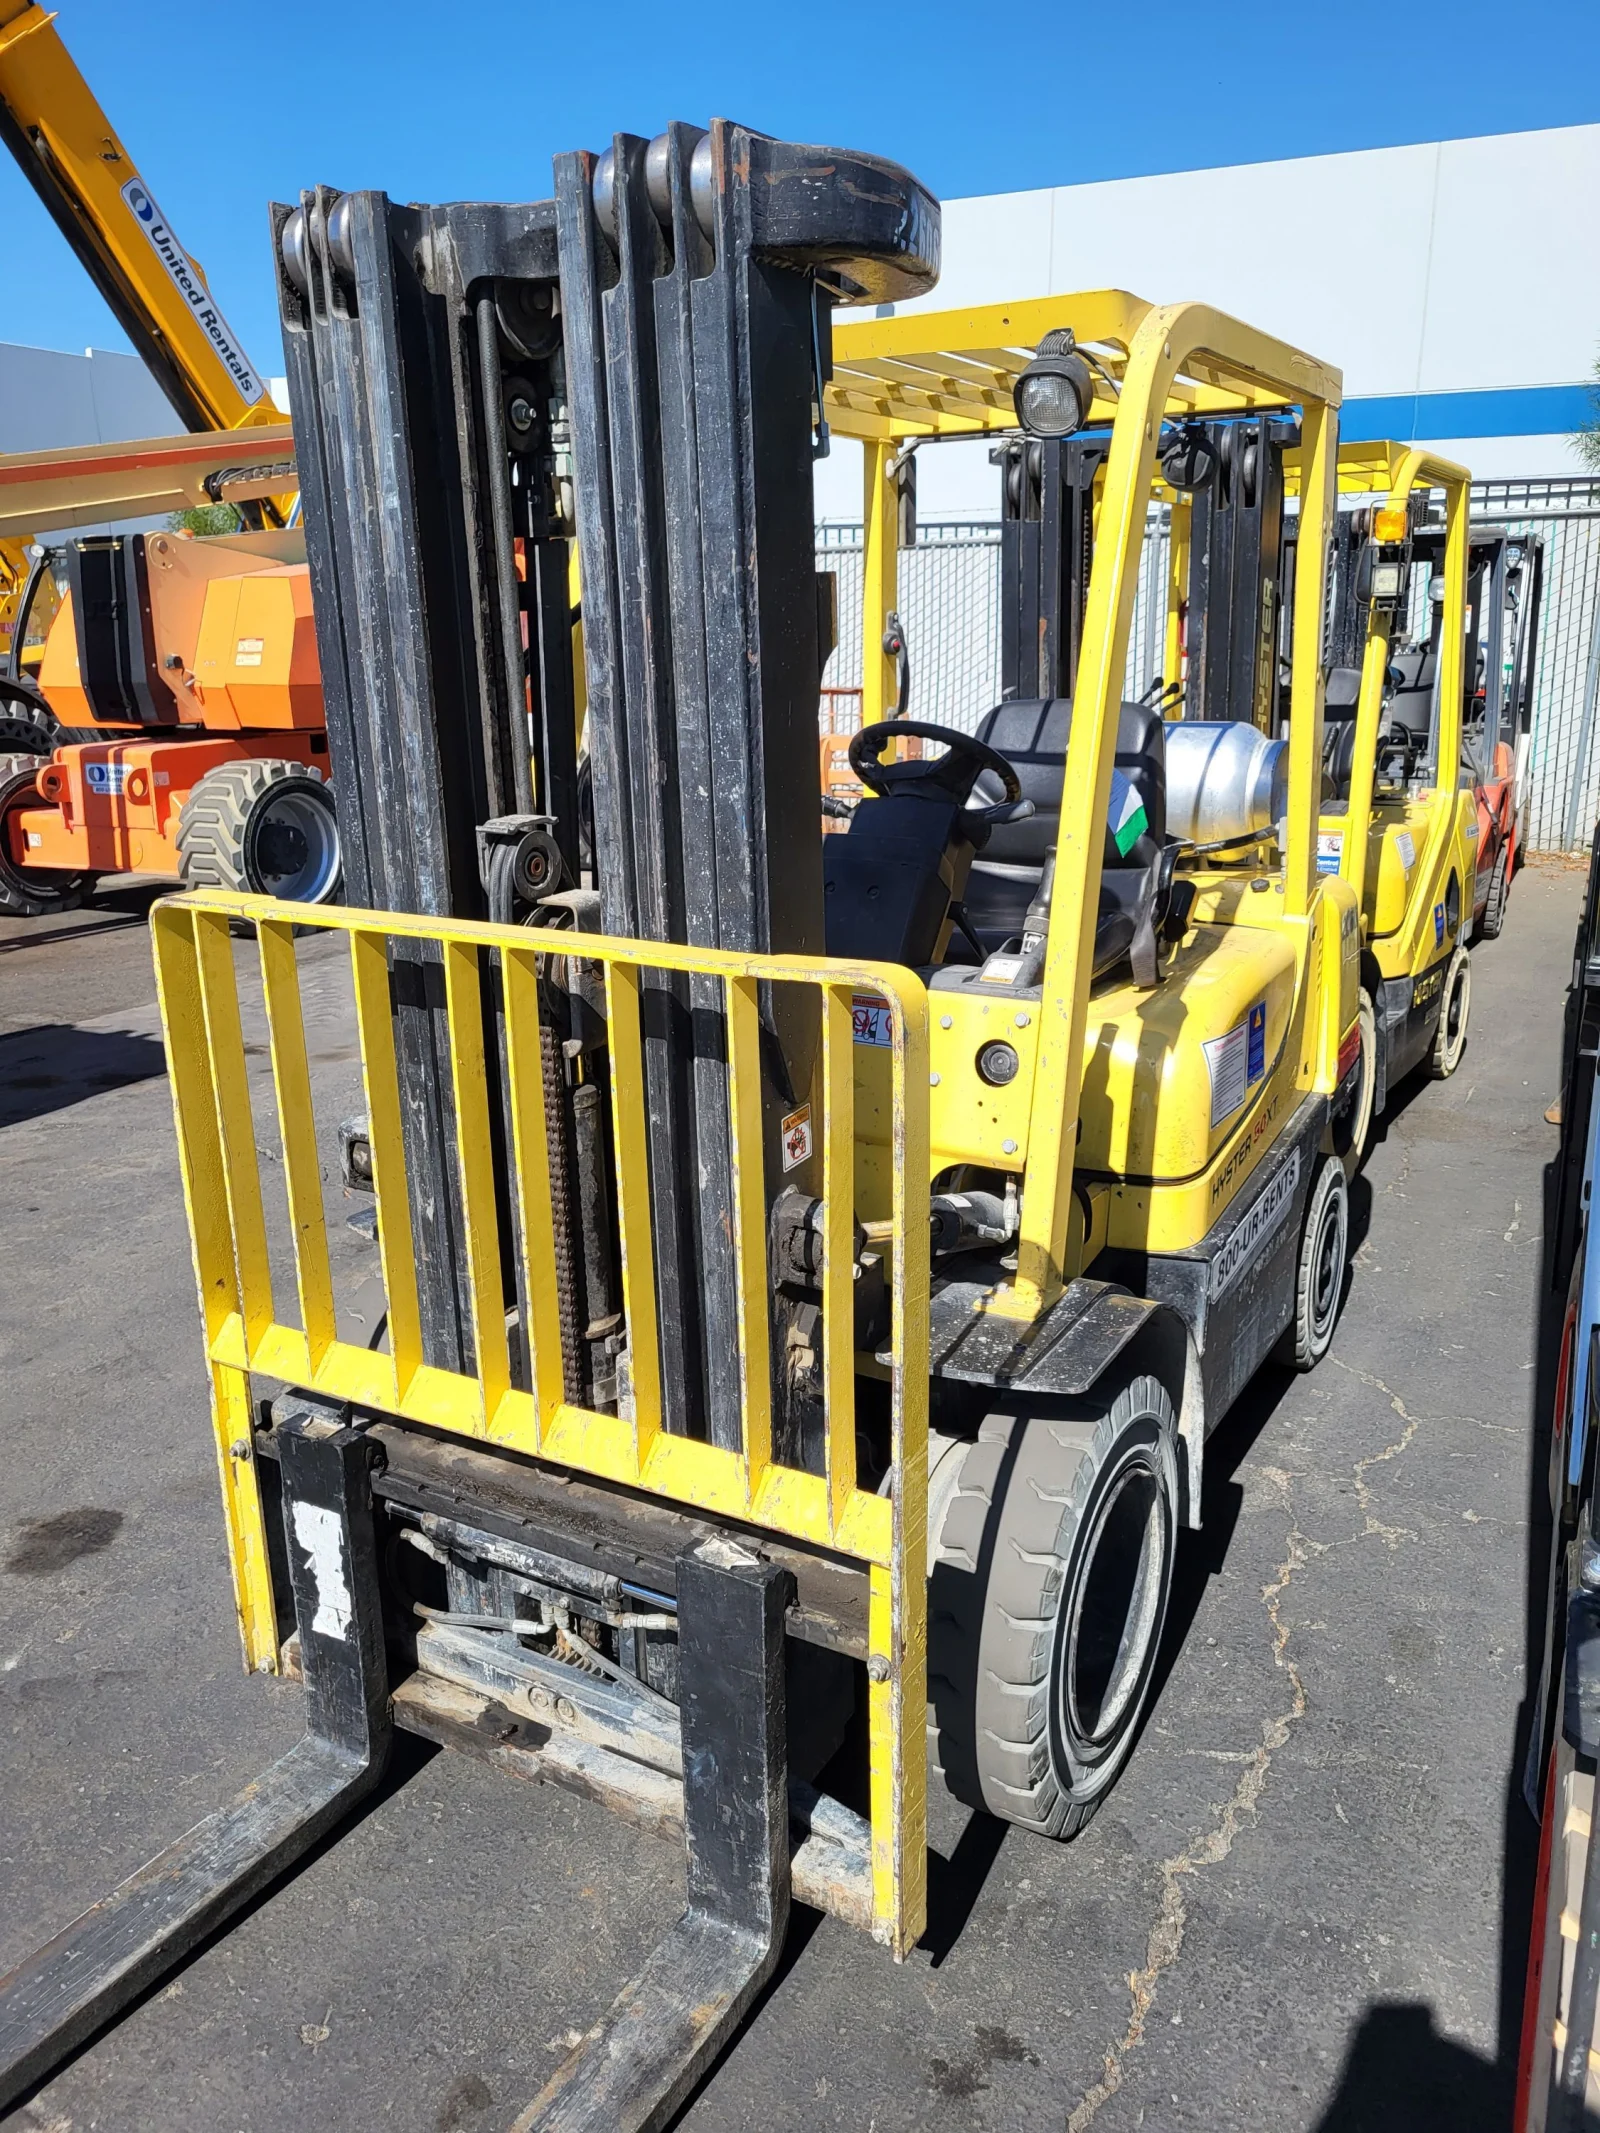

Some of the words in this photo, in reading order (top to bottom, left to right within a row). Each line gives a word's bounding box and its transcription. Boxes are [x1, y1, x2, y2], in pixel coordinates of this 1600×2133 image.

[150, 225, 205, 306] United
[199, 309, 253, 392] Rentals
[1258, 577, 1273, 736] HYSTER
[1212, 1133, 1252, 1204] HYSTER
[1253, 1095, 1279, 1144] 50XT
[1217, 1159, 1296, 1288] 800-UR-RENTS
